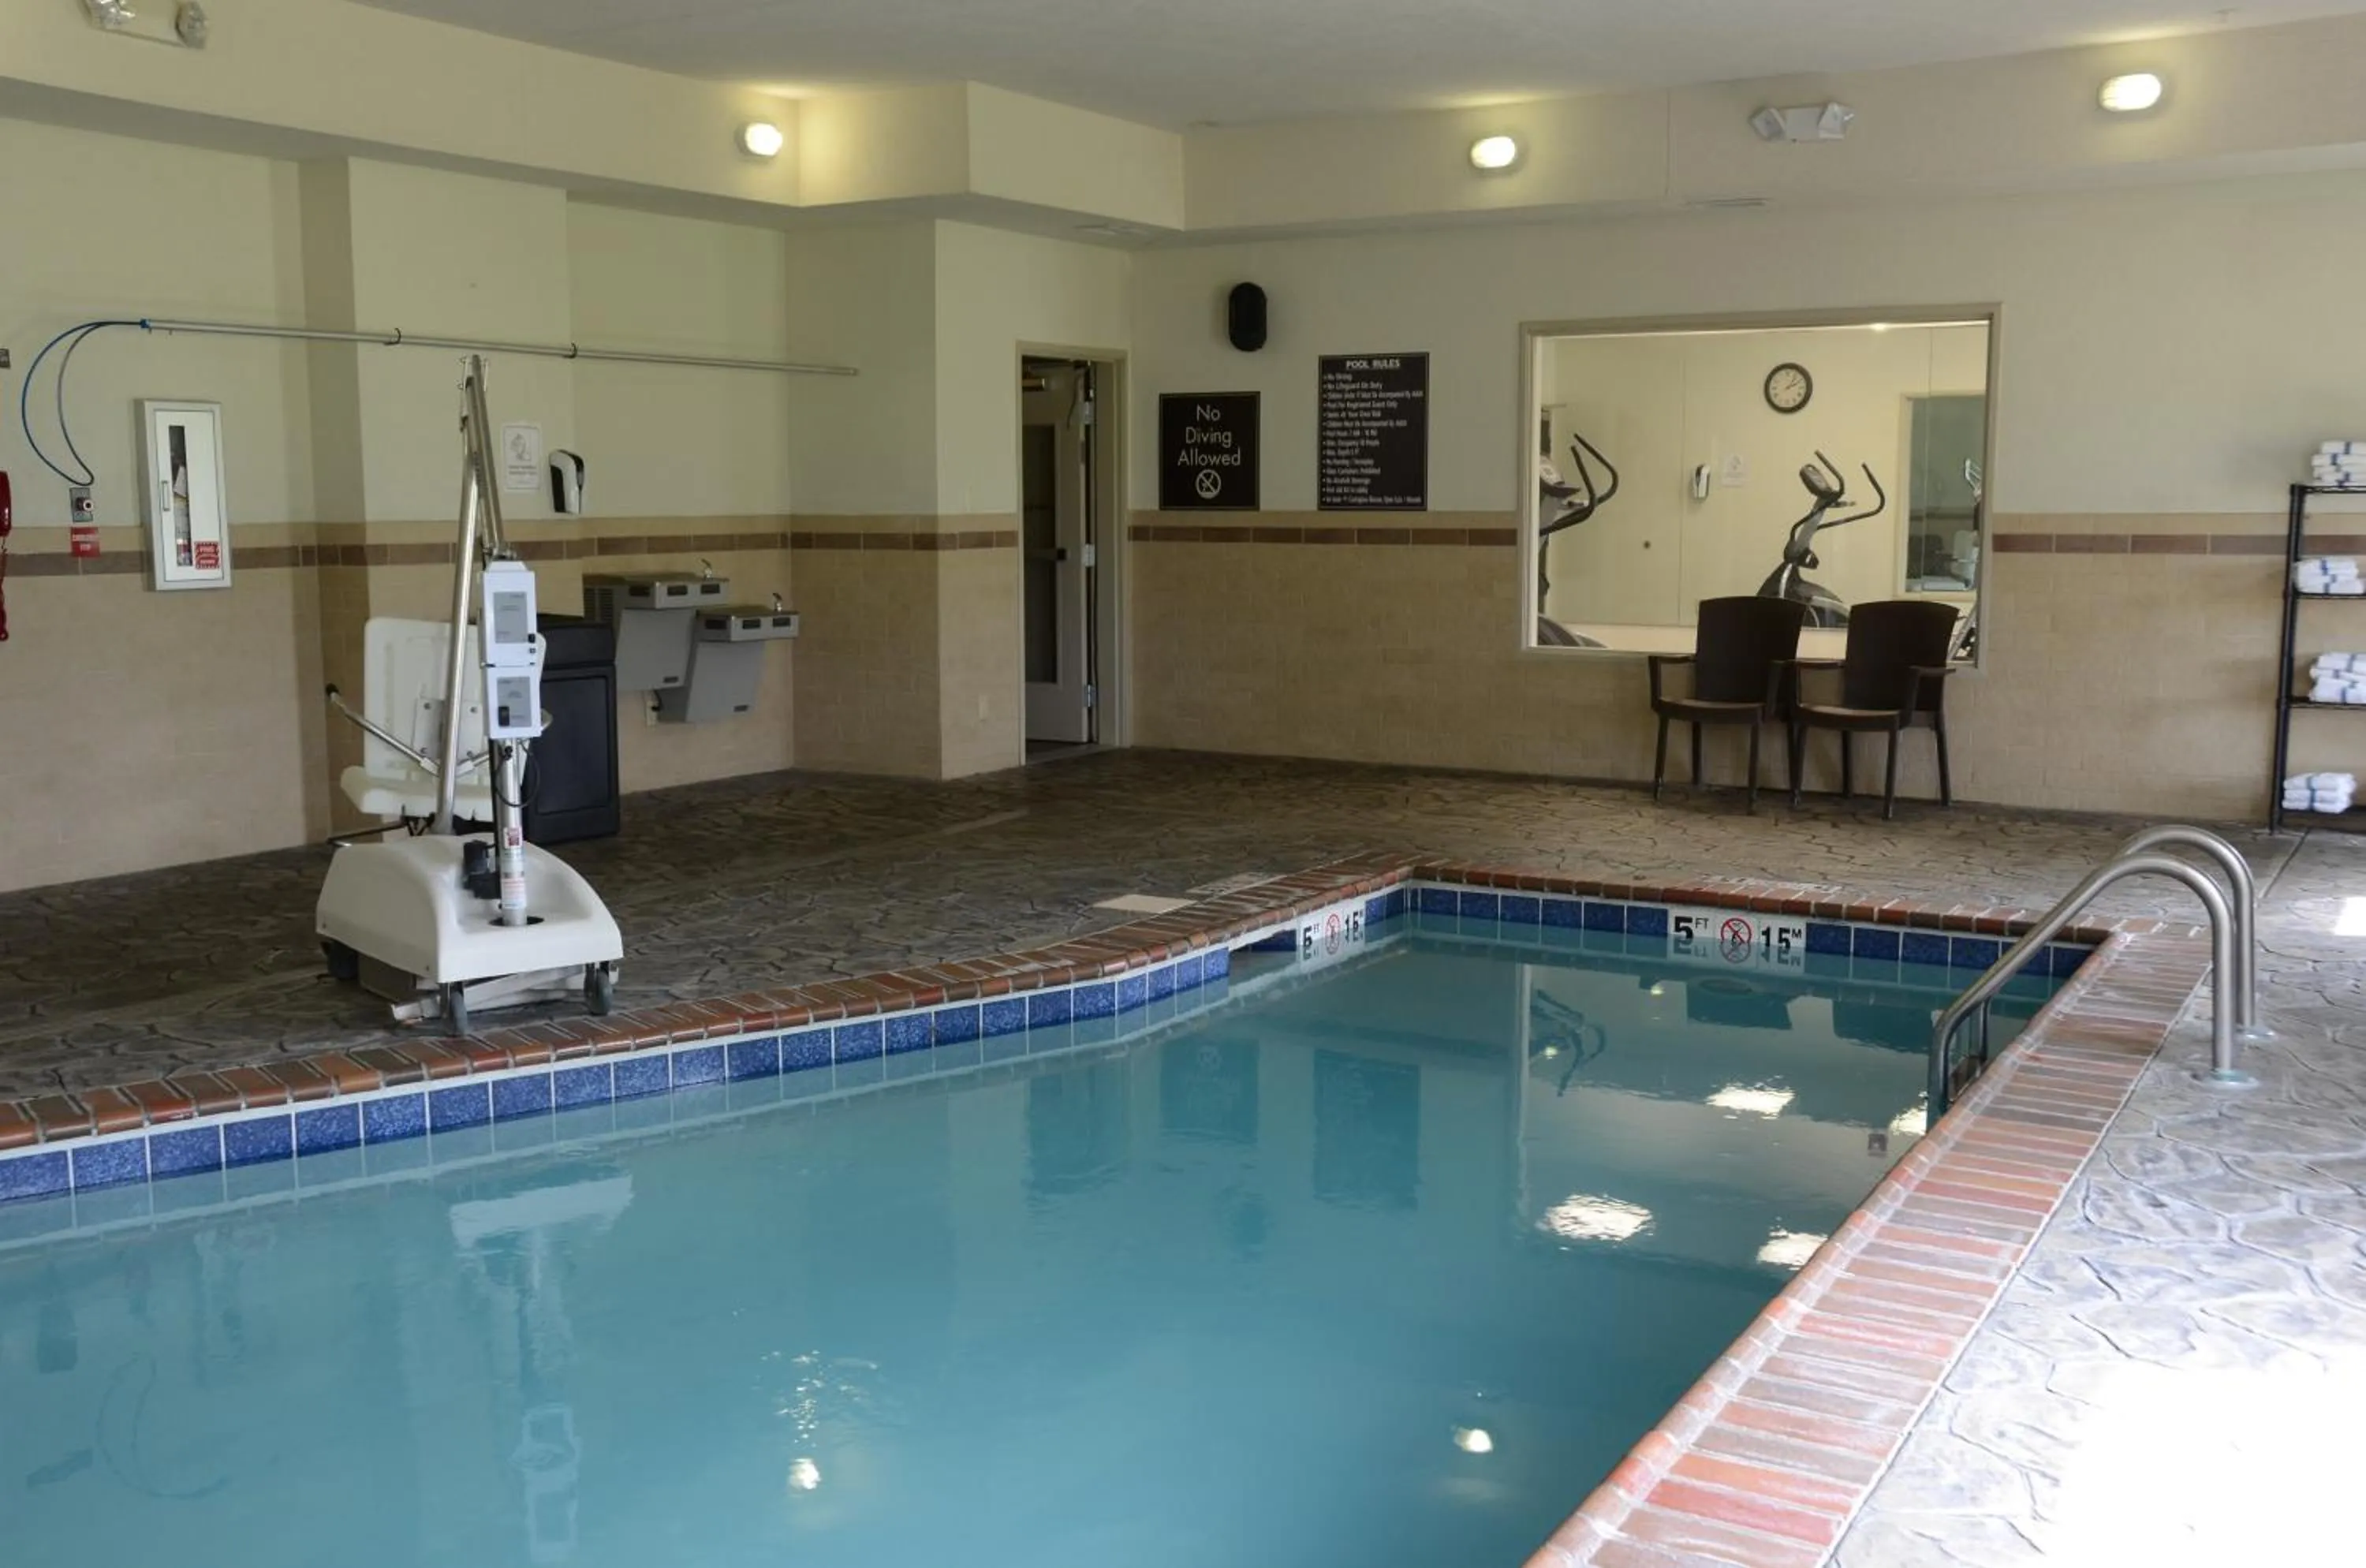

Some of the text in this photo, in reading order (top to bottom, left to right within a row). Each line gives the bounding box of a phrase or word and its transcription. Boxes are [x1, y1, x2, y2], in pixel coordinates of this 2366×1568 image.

[1345, 359, 1401, 370] POOL RULES
[1196, 403, 1221, 421] No
[1185, 426, 1232, 448] Diving
[1177, 446, 1241, 466] Allowed
